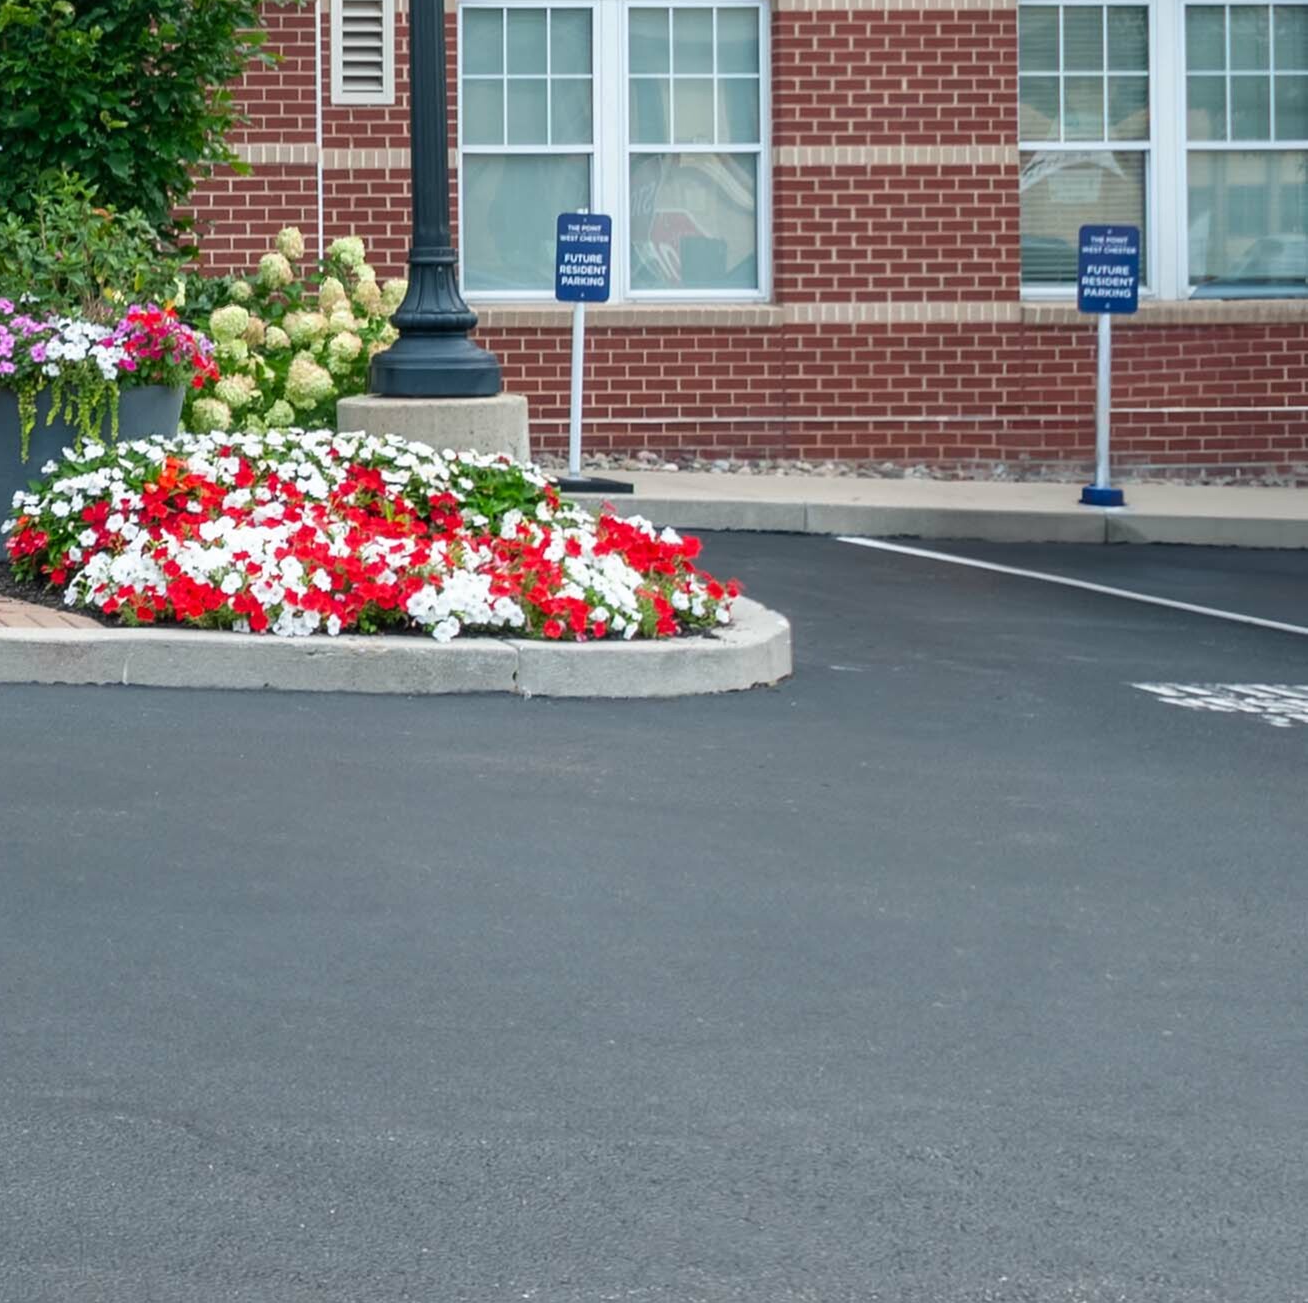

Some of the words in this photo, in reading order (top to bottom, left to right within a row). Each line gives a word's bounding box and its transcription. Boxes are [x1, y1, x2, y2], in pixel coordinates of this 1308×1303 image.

[564, 253, 603, 264] FUTURE
[559, 265, 607, 275] RESIDENT
[1087, 265, 1130, 275] FUTURE
[561, 276, 605, 287] PARKING
[1081, 277, 1134, 287] RESIDENT
[1083, 288, 1132, 298] PARKING
